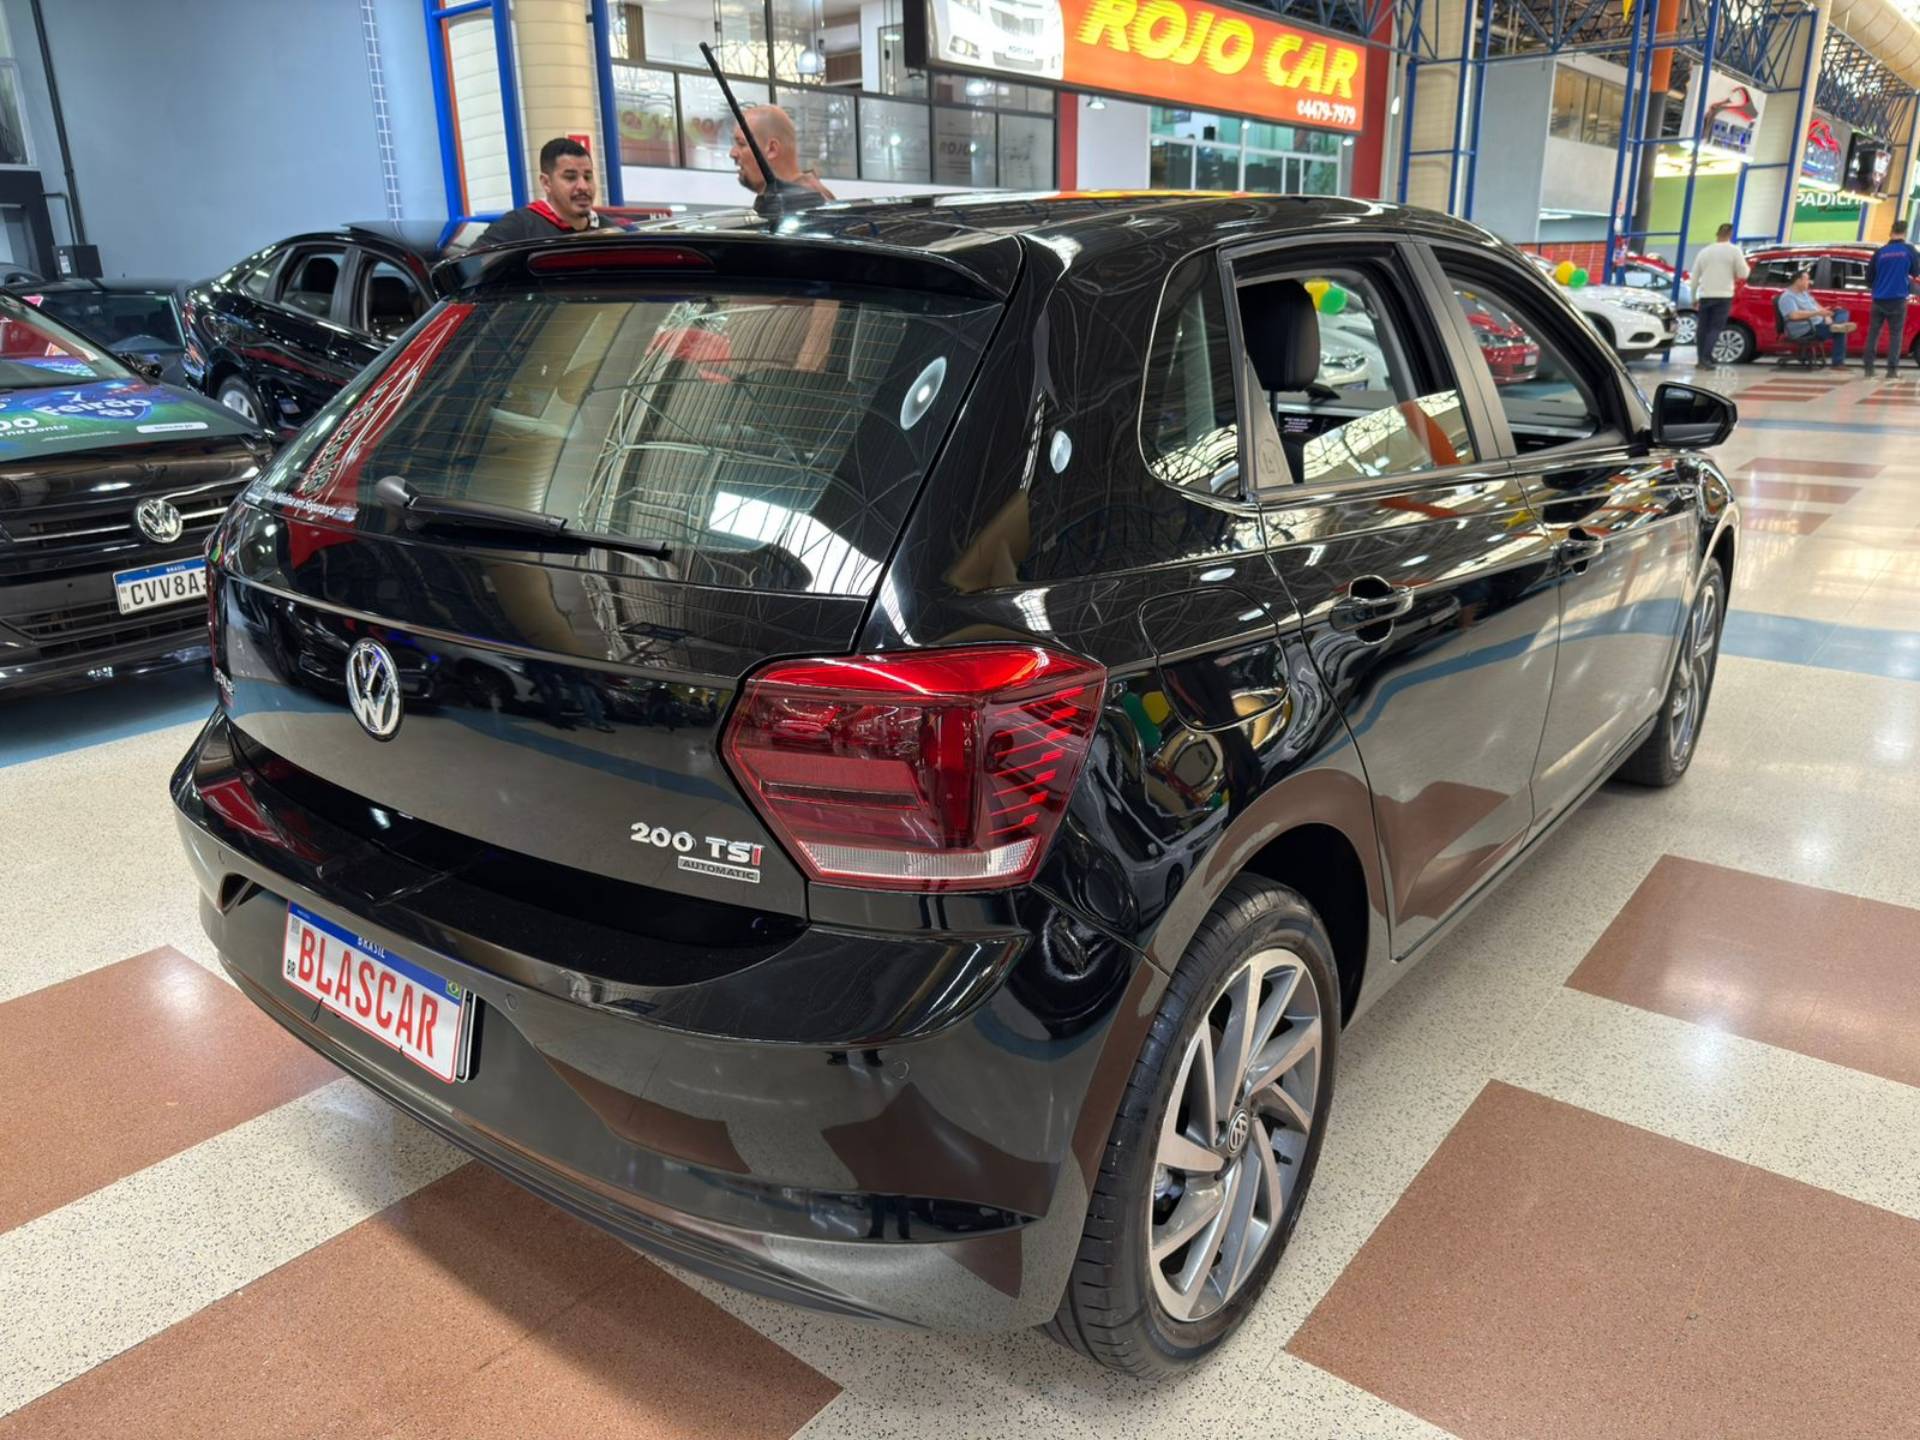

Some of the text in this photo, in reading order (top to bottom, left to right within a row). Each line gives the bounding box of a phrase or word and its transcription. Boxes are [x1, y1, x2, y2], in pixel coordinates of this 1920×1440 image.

[1076, 0, 1360, 99] ROJO CAR
[1797, 192, 1865, 207] PADILH
[130, 571, 207, 606] CVV8A
[630, 822, 763, 865] 200 TSI
[681, 860, 756, 881] AUTOMATIC
[298, 926, 439, 1058] BLASCAR
